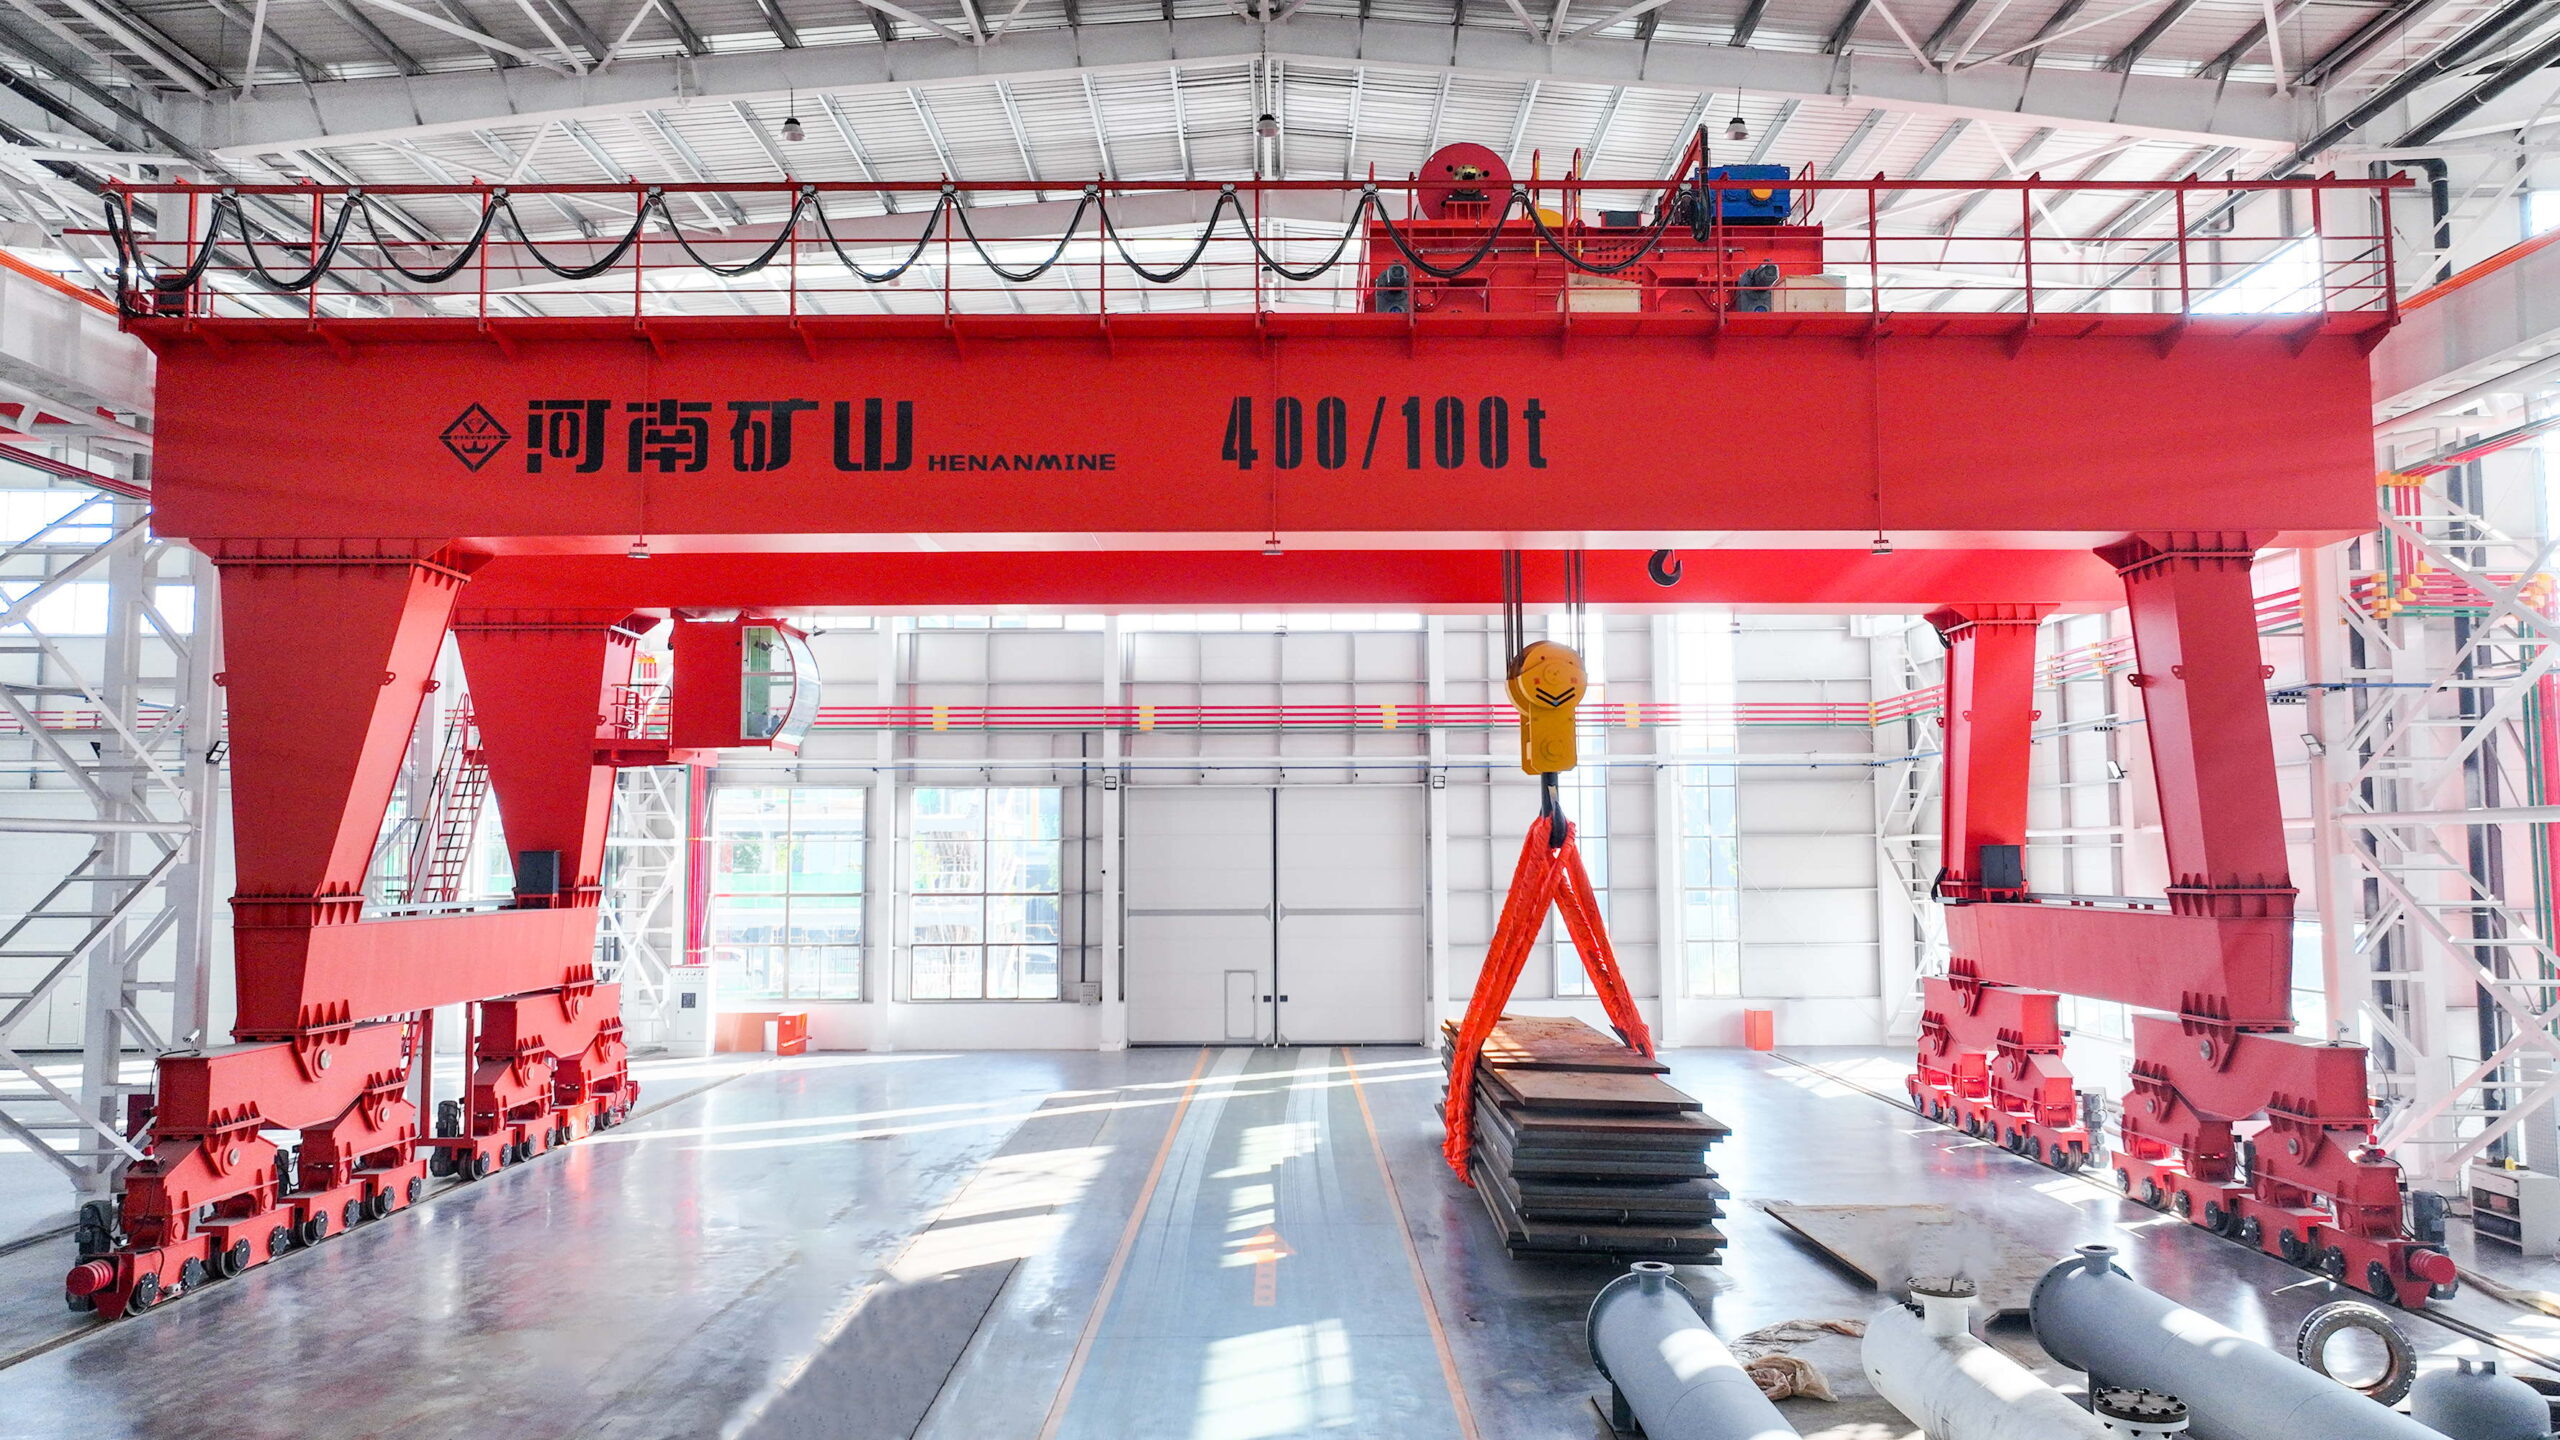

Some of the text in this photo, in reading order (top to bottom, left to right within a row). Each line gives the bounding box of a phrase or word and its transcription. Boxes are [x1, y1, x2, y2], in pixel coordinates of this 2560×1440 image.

[526, 398, 914, 474] 河南矿山
[929, 454, 1116, 472] HENANMINE
[1222, 396, 1549, 471] 400/100t
